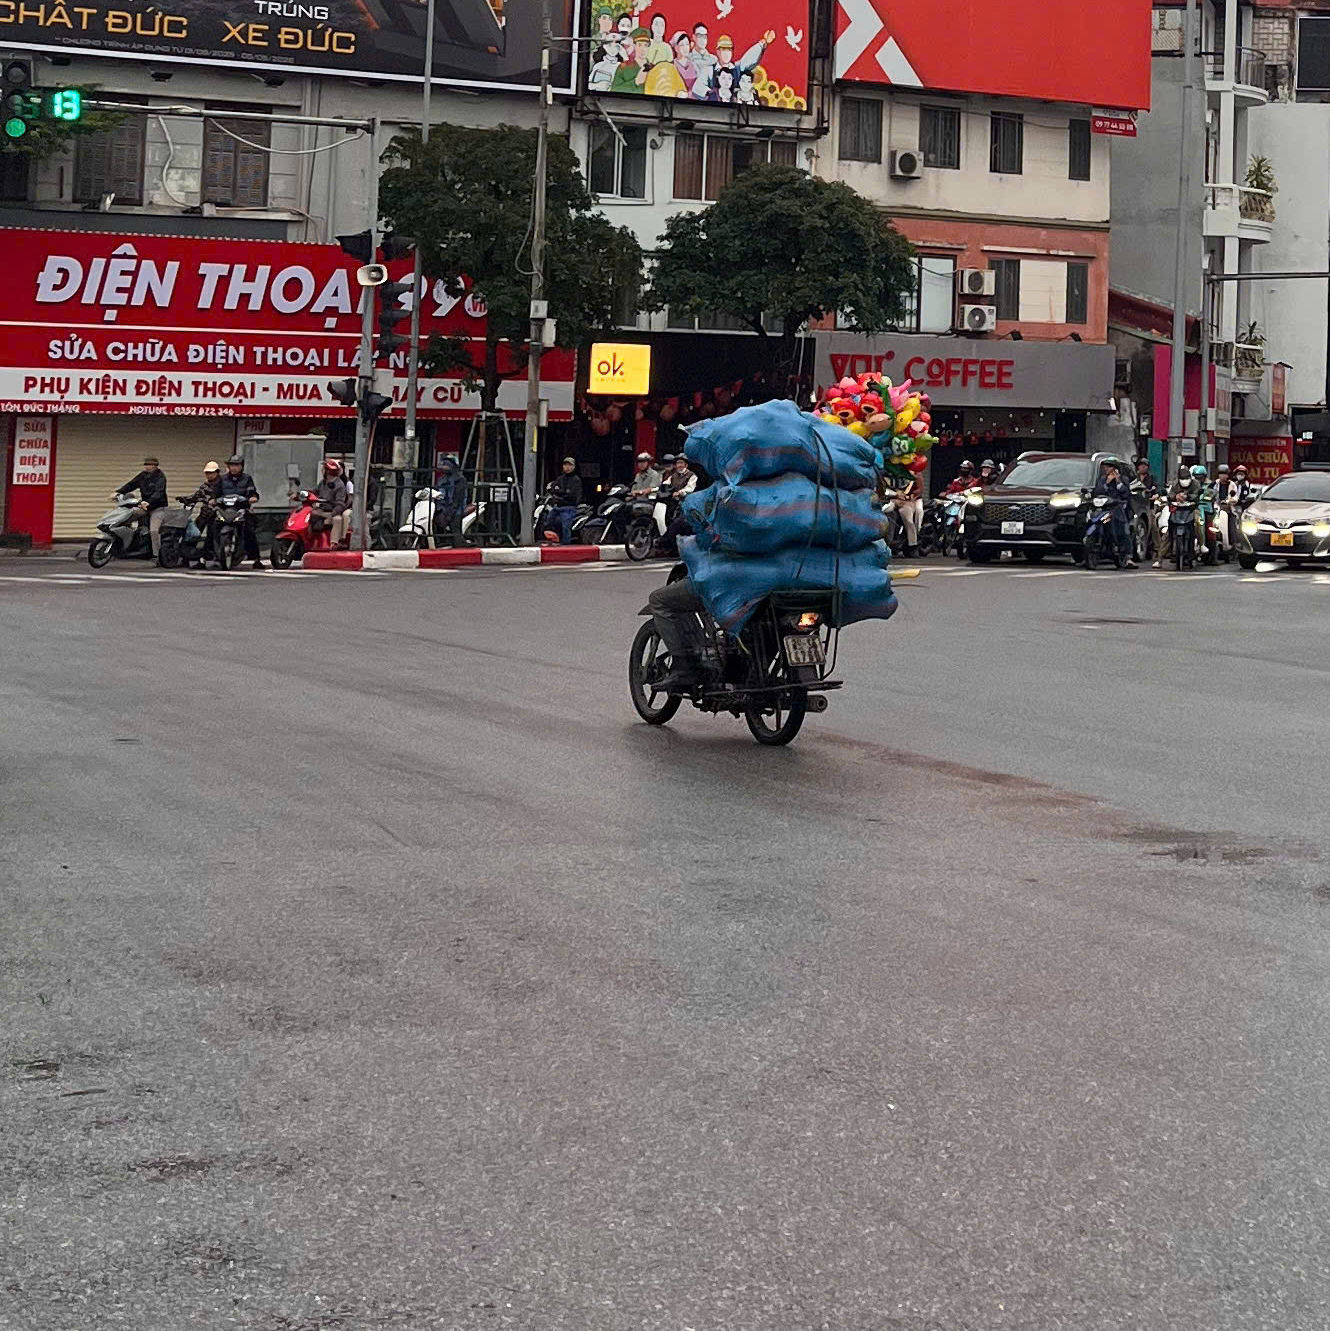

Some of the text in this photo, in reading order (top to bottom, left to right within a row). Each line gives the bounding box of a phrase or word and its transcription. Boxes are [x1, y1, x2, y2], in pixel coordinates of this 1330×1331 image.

[105, 6, 188, 39] ĐỨC
[253, 0, 329, 20] TRÚNG
[221, 20, 356, 54] XE ĐỨC
[35, 243, 180, 322] ĐIỆN
[48, 333, 98, 361] SỬA
[106, 339, 179, 364] CHỮA
[187, 339, 244, 369] ĐIỆN
[252, 346, 329, 370] THOẠI
[23, 375, 71, 400] PHỤ
[79, 373, 127, 401] KIỆN
[134, 374, 183, 402] ĐIỆN
[191, 380, 256, 404] THOẠI
[276, 382, 322, 401] MUA
[432, 382, 463, 403] CŨ
[904, 356, 1015, 390] COFFEE
